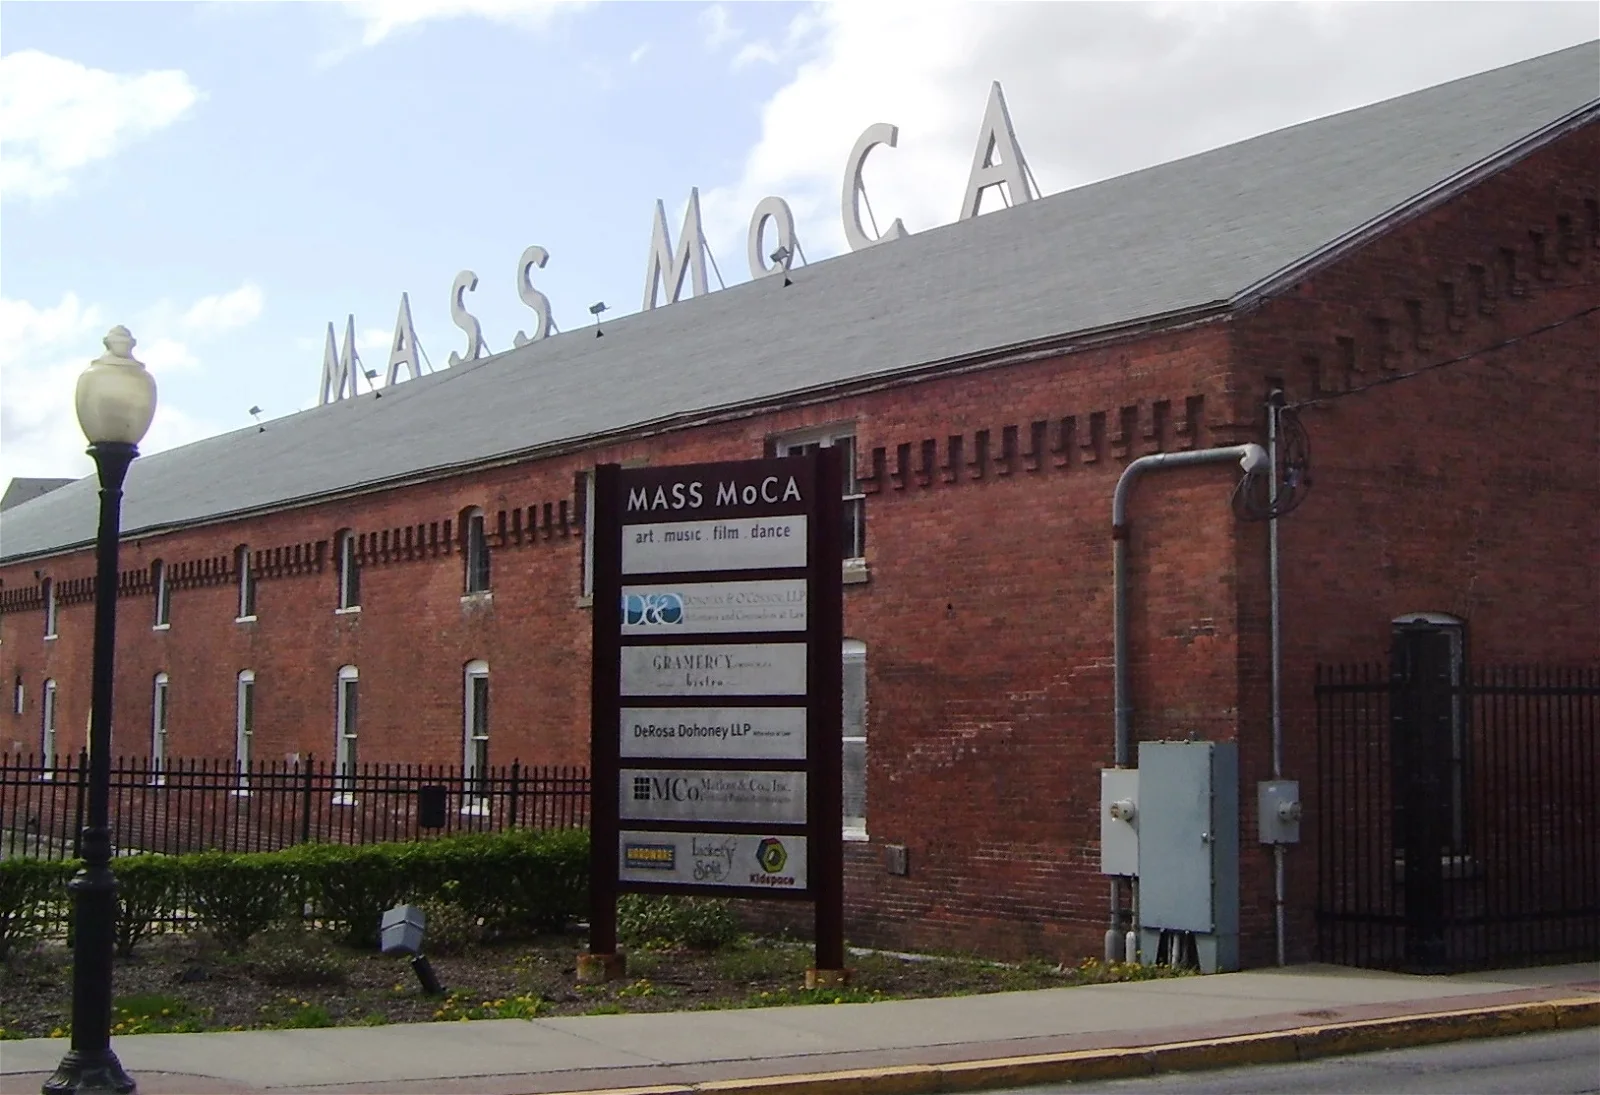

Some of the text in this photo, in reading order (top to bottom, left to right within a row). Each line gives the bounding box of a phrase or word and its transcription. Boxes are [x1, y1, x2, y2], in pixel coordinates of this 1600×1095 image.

[320, 245, 553, 404] MASS
[627, 476, 801, 511] MASS MoCA
[636, 524, 791, 543] art music film dance
[653, 654, 733, 670] GRAMERCY
[686, 673, 724, 687] bistro
[634, 724, 675, 738] DeRosa
[678, 723, 729, 740] Dohoney
[731, 723, 751, 737] LLP
